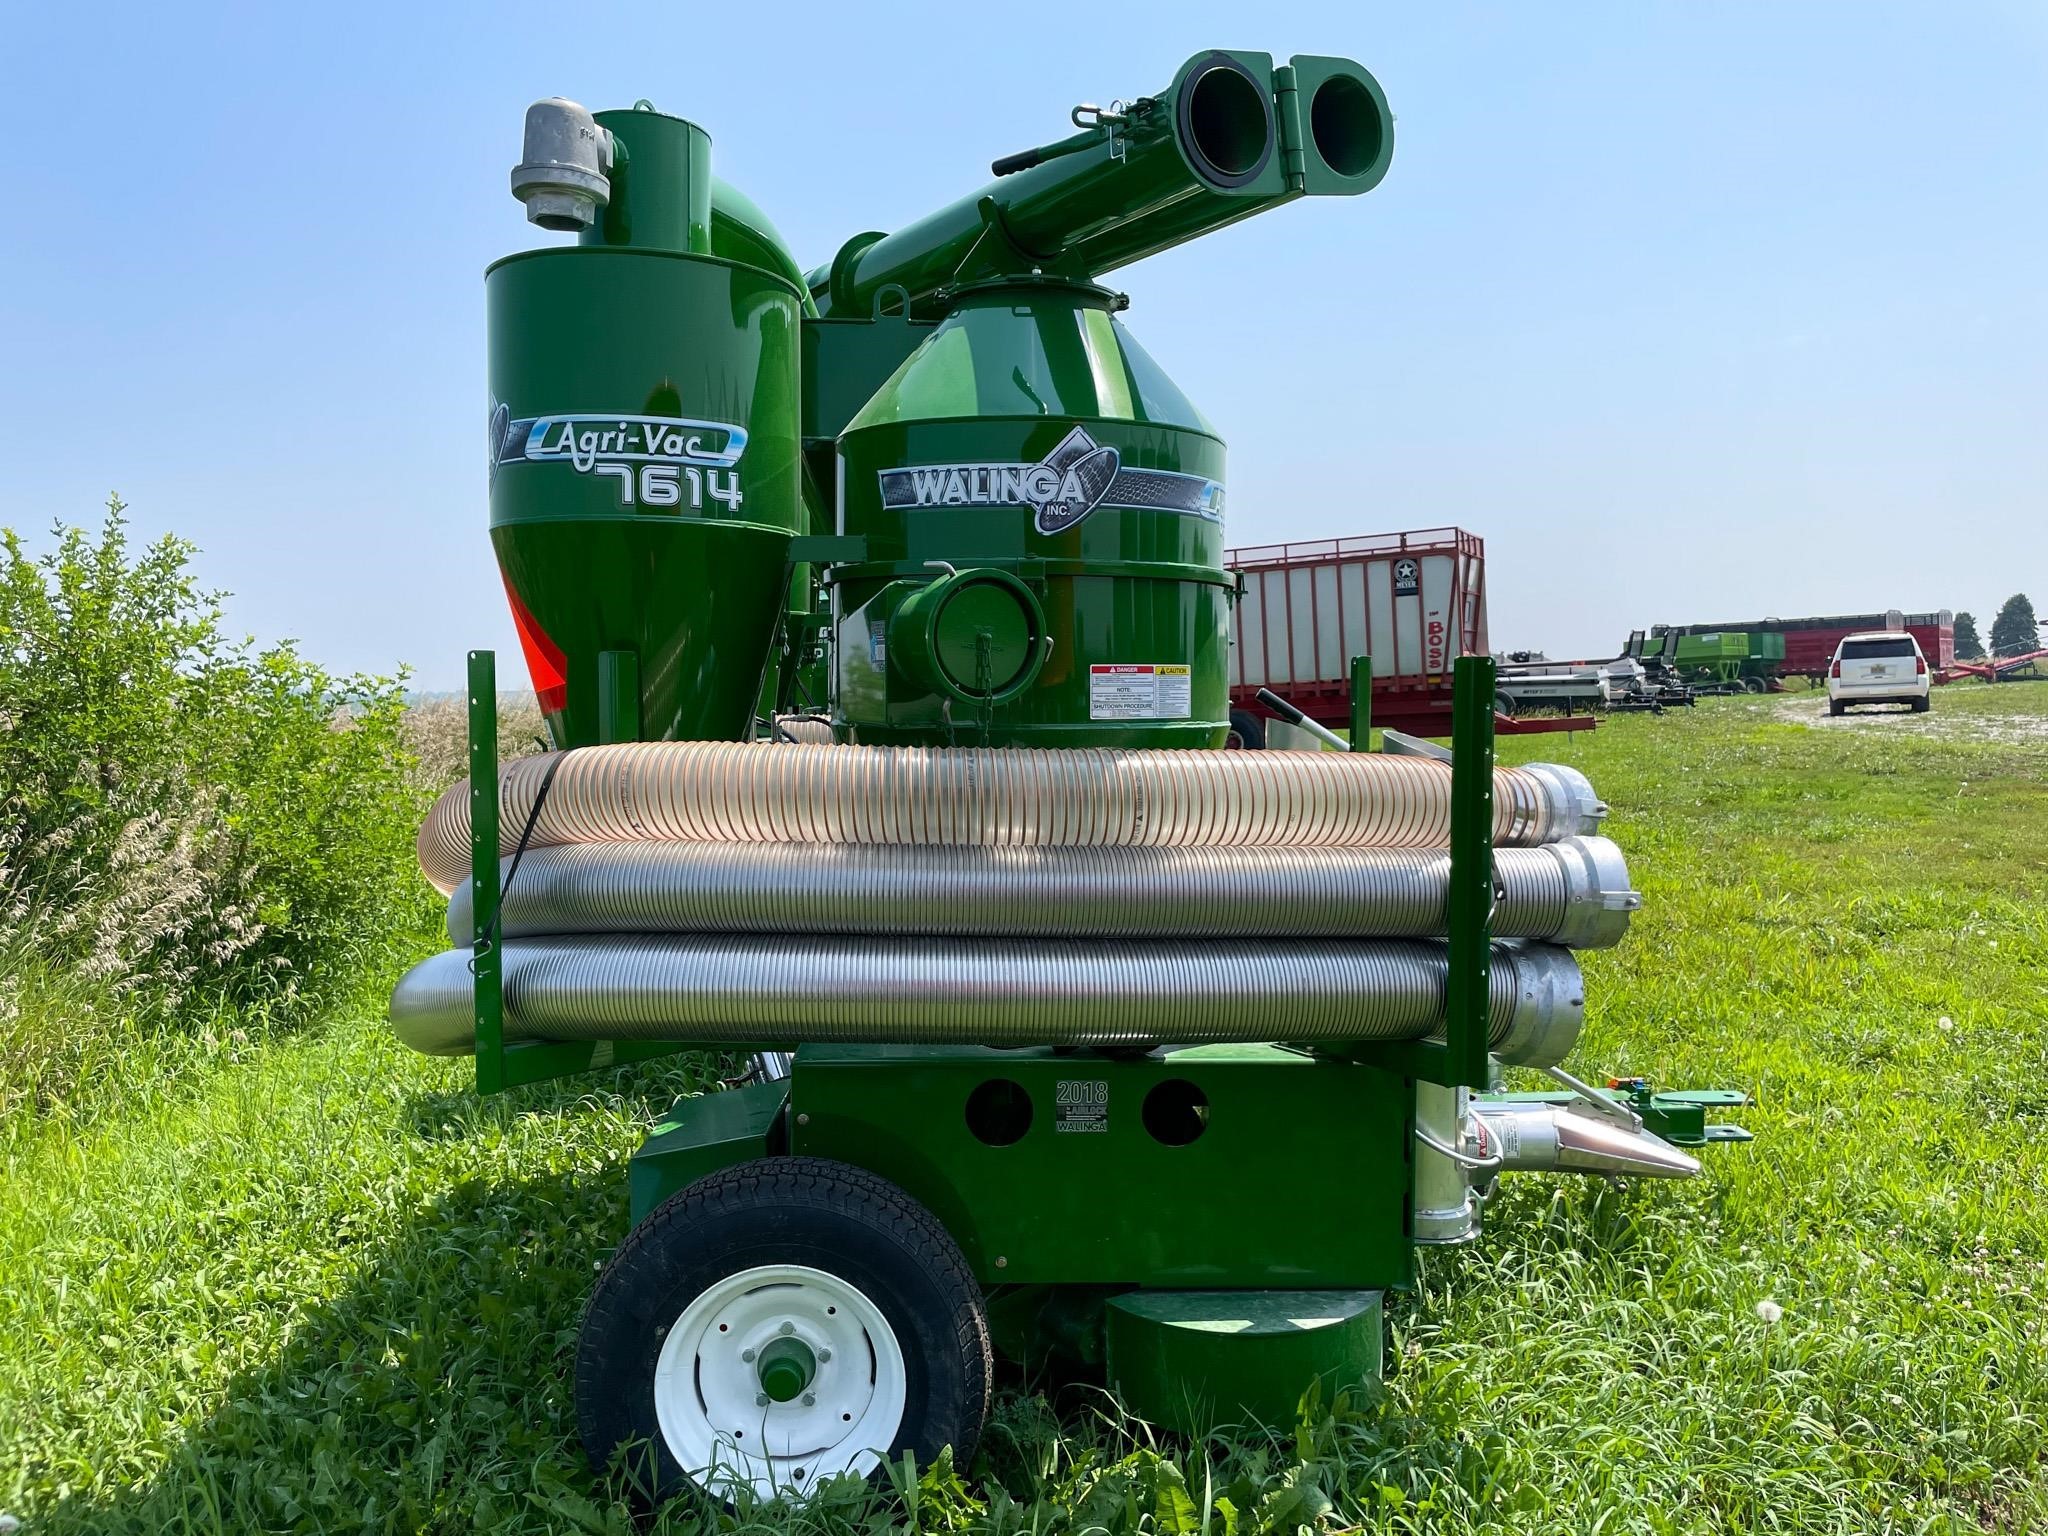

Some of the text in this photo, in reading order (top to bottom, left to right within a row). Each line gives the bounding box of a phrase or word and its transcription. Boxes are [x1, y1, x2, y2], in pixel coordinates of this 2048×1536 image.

[559, 421, 702, 472] Agri-Vac
[595, 463, 743, 511] 7614
[912, 466, 1086, 505] WALINGA
[1046, 504, 1071, 518] INC.
[1429, 621, 1443, 668] BOSS
[1057, 1082, 1108, 1103] 2018
[1056, 1121, 1107, 1132] WALINGA
